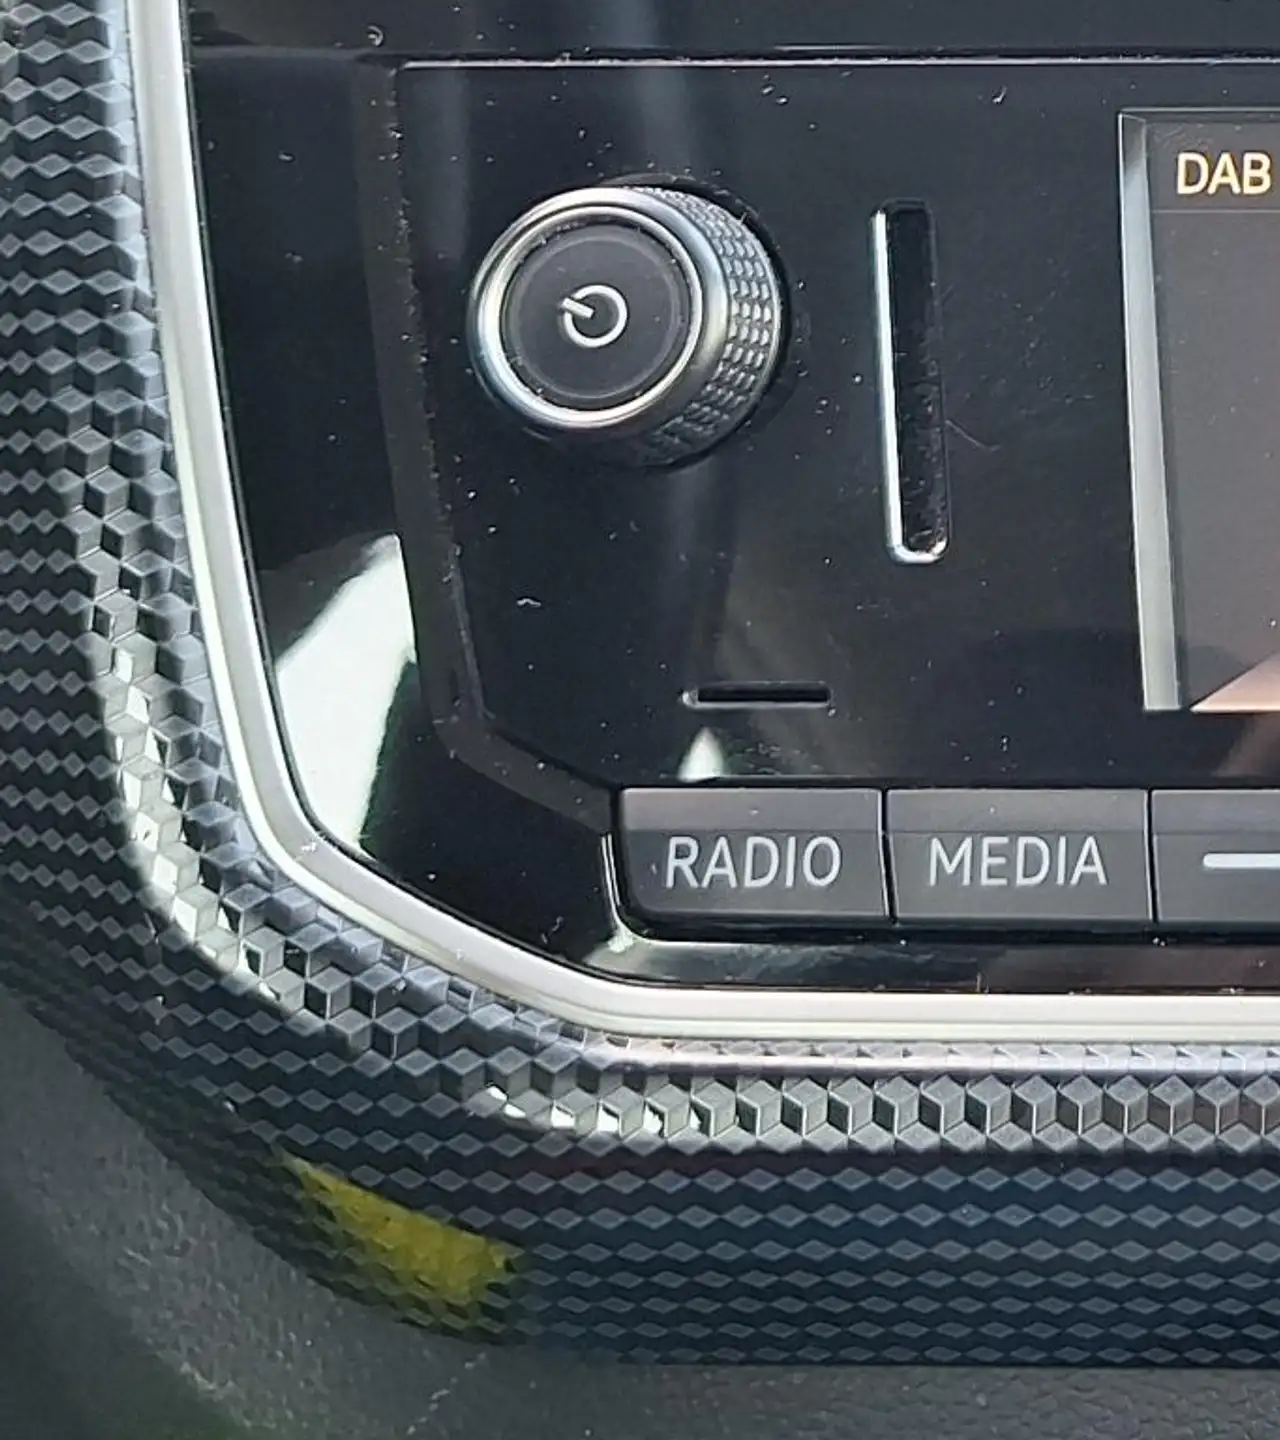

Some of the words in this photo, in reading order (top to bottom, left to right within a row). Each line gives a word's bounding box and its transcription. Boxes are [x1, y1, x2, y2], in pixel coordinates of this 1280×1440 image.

[1177, 152, 1271, 195] DAB
[666, 836, 841, 888] RADIO
[929, 836, 1106, 886] MEDIA
